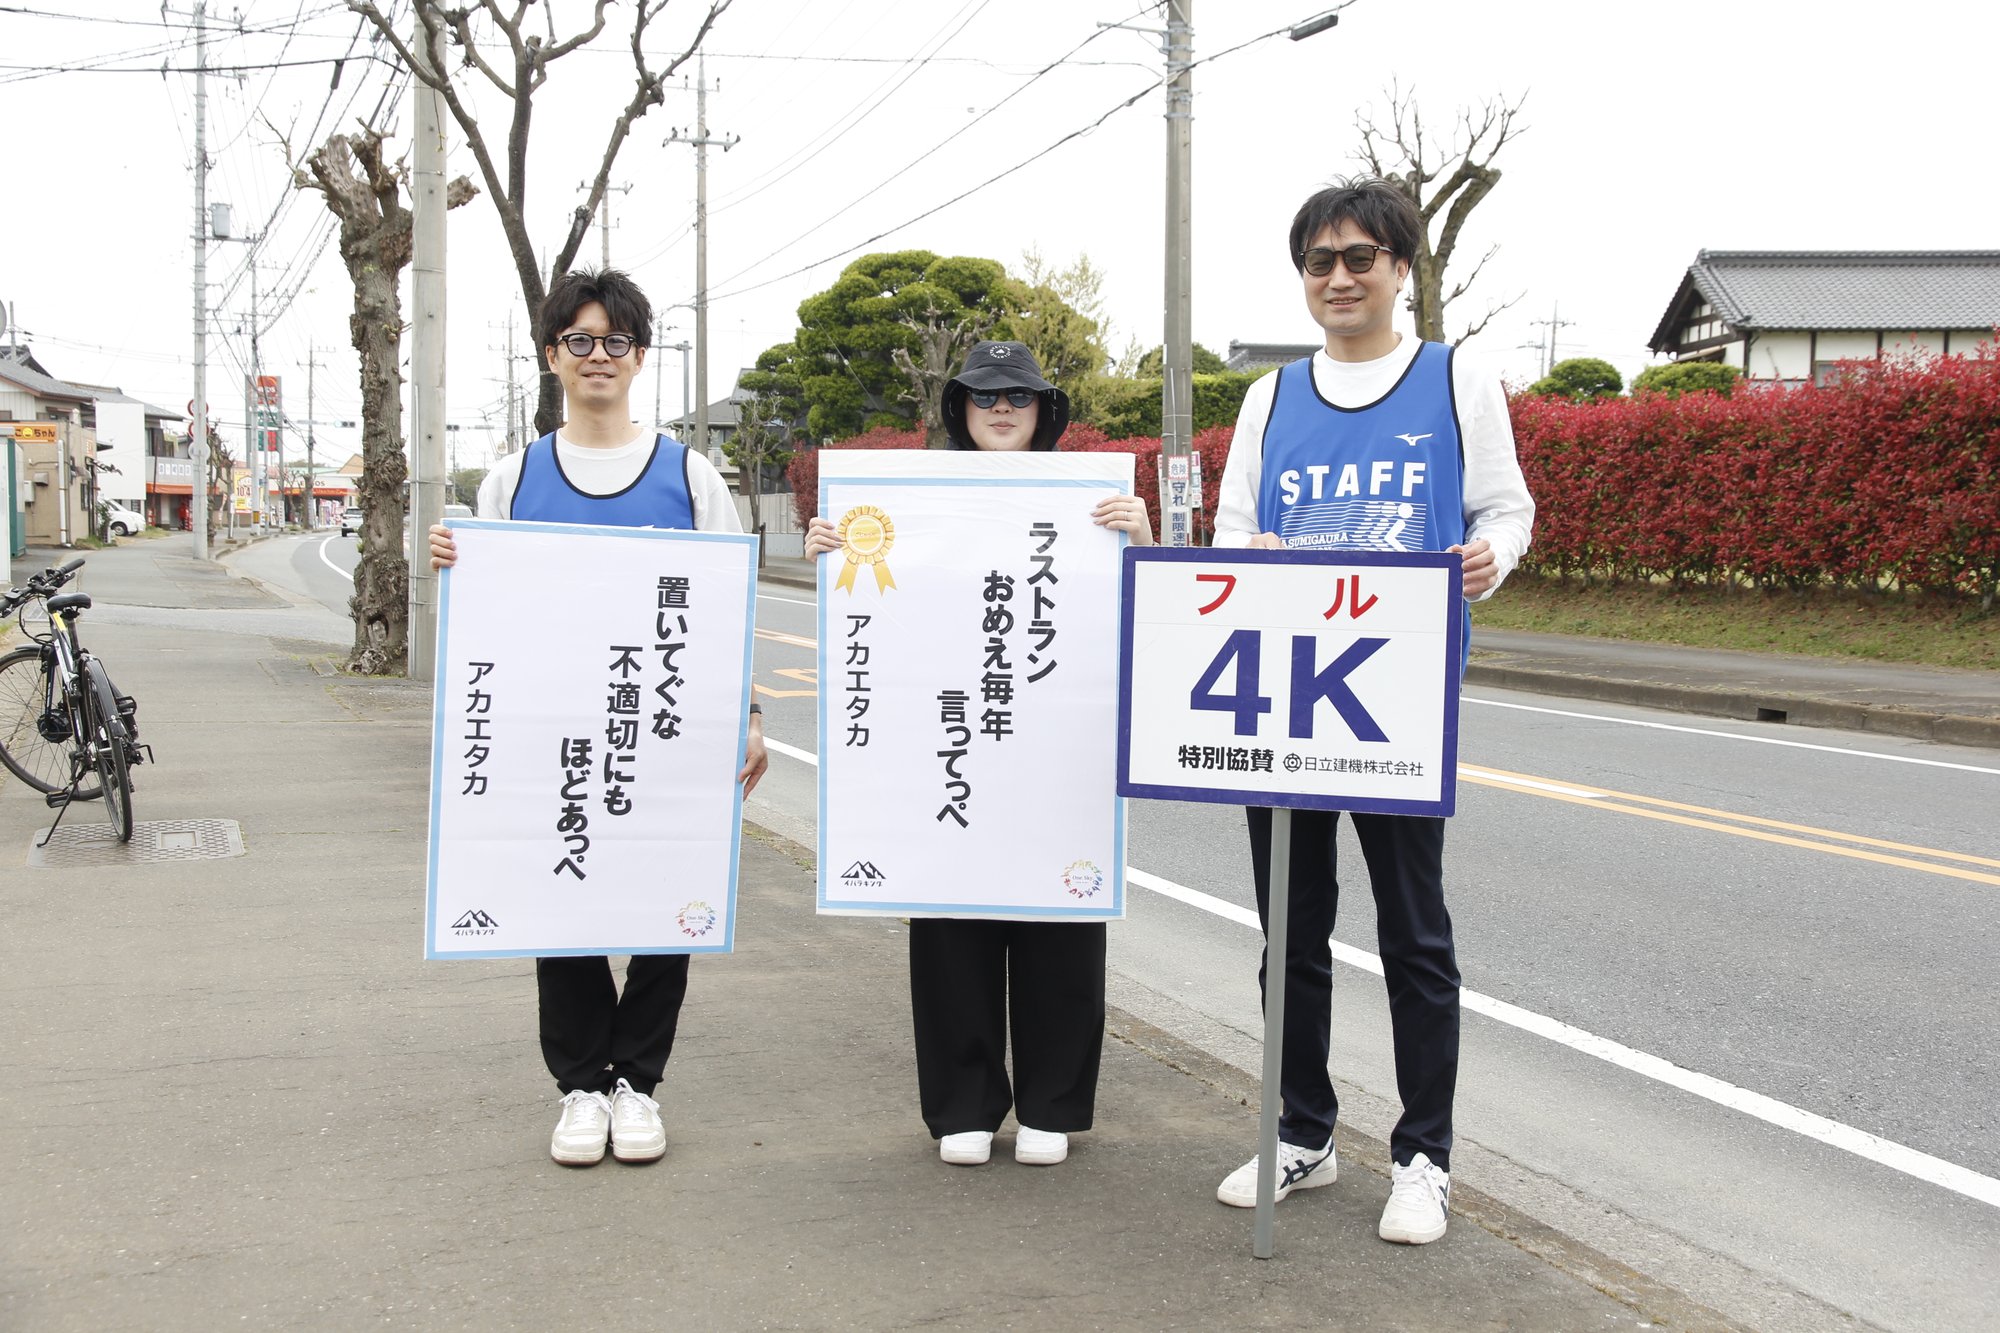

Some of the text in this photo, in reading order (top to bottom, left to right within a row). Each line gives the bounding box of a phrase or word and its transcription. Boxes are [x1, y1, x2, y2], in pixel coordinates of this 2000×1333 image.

[1172, 482, 1186, 507] 守れ
[1279, 460, 1427, 506] STAFF
[651, 576, 691, 740] 置いてぐな
[980, 569, 1016, 742] おめえ毎年
[1026, 522, 1059, 684] ラストラン
[1196, 574, 1379, 621] フル
[461, 661, 495, 796] アカエタカ
[603, 645, 644, 816] 不適切にも
[845, 614, 872, 747] アカエタカ
[1190, 629, 1391, 743] 4K
[553, 737, 593, 881] ほどあっぺ
[936, 690, 972, 829] 言ってっぺ
[1177, 744, 1424, 777] 特別協賛 日立建機株式会社
